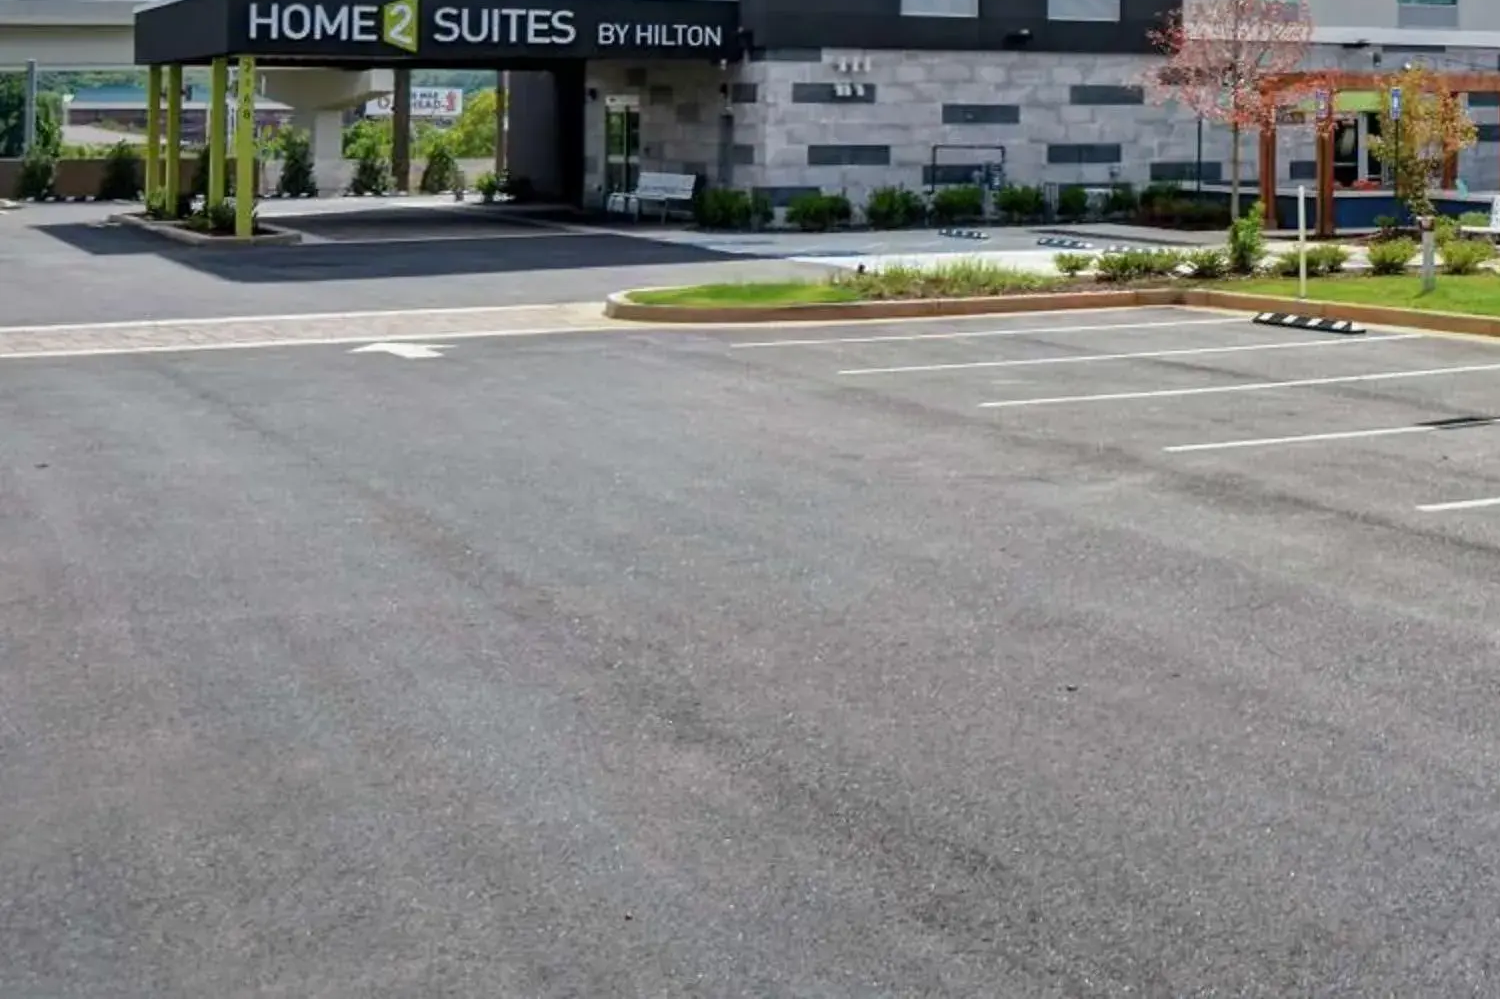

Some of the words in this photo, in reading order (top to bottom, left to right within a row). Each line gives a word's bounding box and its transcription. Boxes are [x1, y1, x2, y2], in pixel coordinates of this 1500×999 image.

[432, 6, 577, 45] SUITES
[597, 22, 629, 46] BY
[635, 24, 722, 47] HILTON
